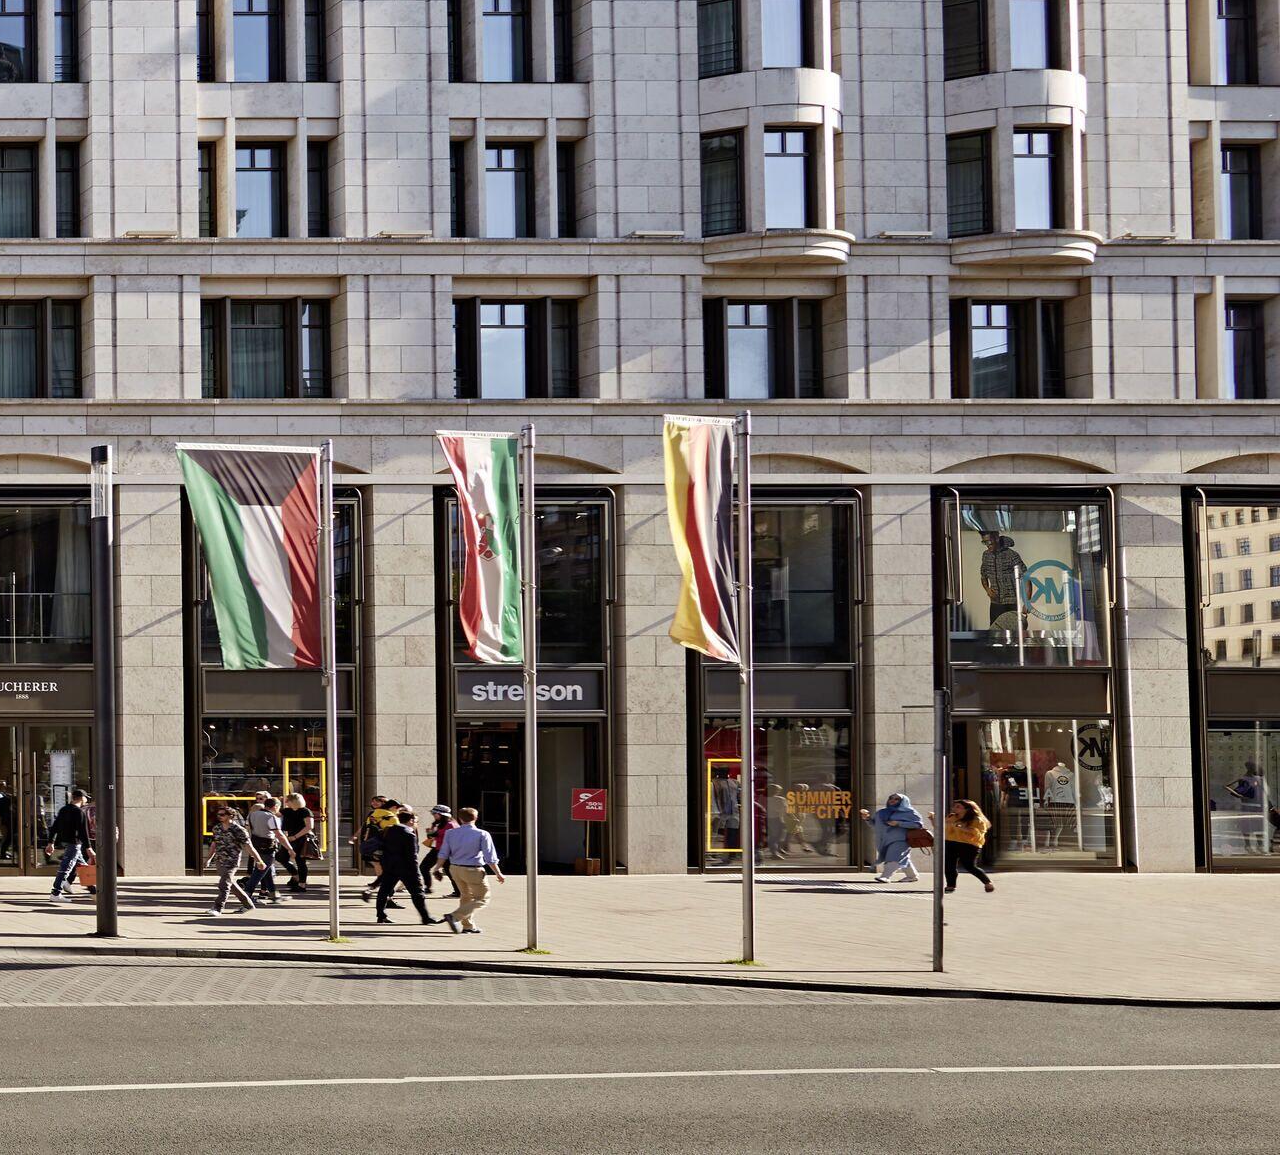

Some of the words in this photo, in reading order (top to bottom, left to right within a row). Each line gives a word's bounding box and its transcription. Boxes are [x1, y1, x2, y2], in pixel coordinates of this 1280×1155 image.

[472, 682, 582, 701] streson
[786, 791, 852, 805] SUMMER
[786, 805, 796, 814] IN
[798, 805, 816, 814] THE
[817, 805, 852, 819] CITY
